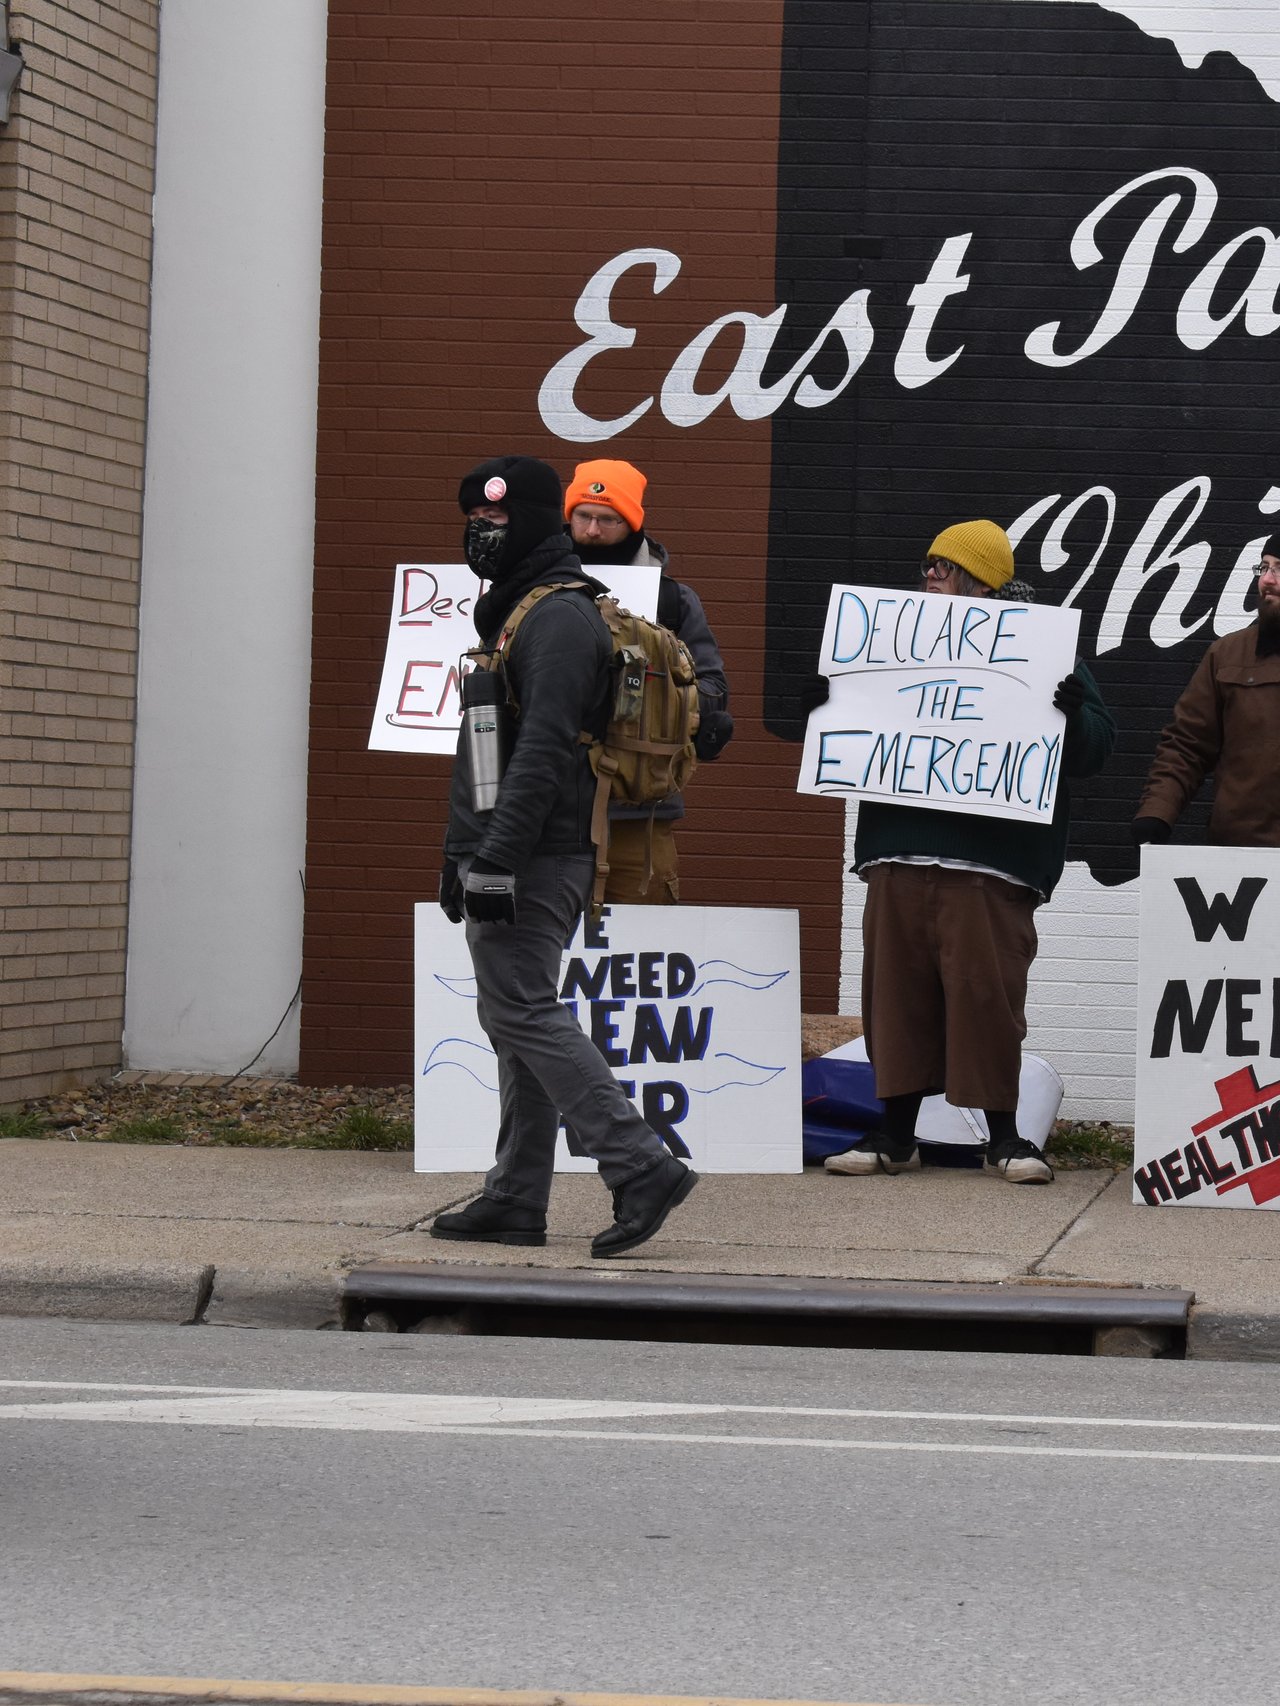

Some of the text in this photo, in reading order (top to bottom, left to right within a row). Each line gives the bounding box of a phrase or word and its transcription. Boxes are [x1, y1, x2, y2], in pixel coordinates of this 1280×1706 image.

[537, 232, 973, 443] East
[832, 592, 1029, 663] DECLARE
[627, 676, 640, 687] TQ
[898, 679, 984, 720] THE
[559, 952, 696, 1000] NEED
